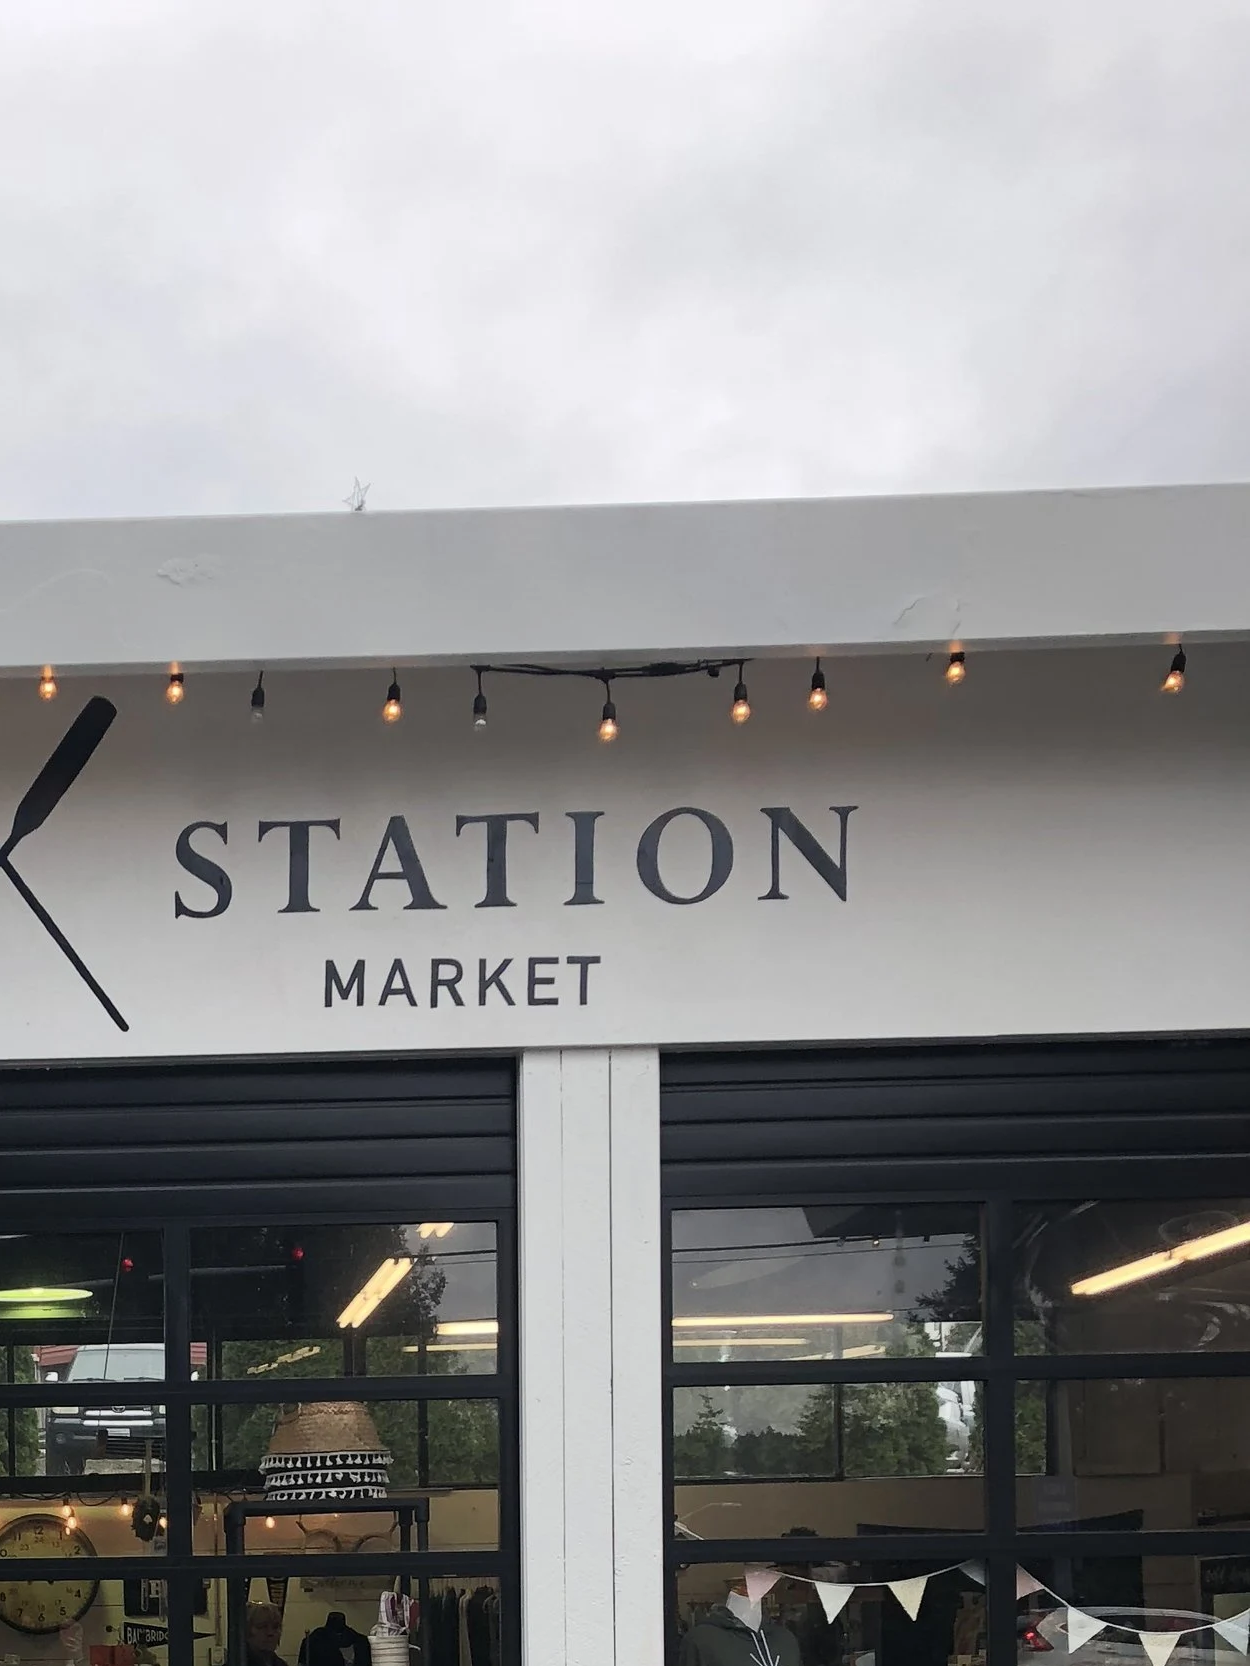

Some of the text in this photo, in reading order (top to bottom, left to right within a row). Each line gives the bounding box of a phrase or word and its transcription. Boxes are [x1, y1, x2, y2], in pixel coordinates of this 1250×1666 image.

[174, 804, 859, 919] STATION
[323, 954, 602, 1009] MARKET
[34, 1525, 44, 1535] 12
[74, 1545, 81, 1555] 2
[0, 1592, 6, 1602] 8
[75, 1589, 81, 1598] 4
[16, 1608, 23, 1618] 7
[59, 1607, 66, 1616] 5
[38, 1613, 45, 1622] 6
